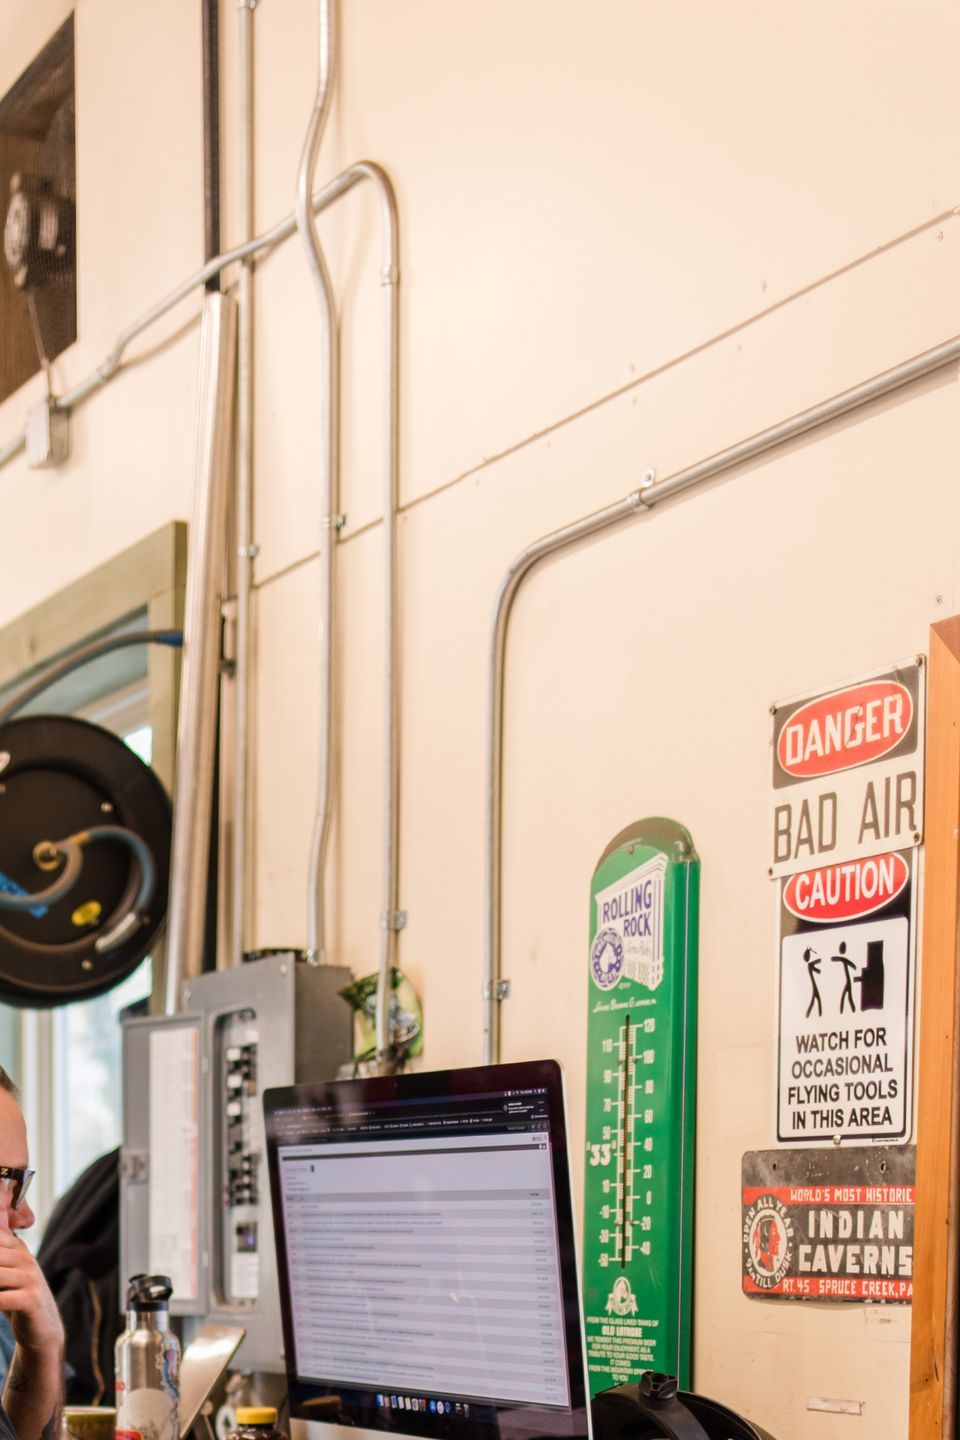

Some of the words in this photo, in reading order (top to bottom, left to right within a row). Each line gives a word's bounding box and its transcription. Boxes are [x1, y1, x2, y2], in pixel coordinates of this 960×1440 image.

[785, 693, 904, 766] DANGER
[773, 791, 837, 864] BAD
[858, 770, 917, 844] AIR
[795, 857, 895, 911] CAUTION
[602, 880, 652, 923] ROLLING
[623, 912, 652, 937] ROCK
[796, 1031, 848, 1054] WATCH
[854, 1027, 887, 1048] FOR
[792, 1053, 893, 1079] OCCASIONAL
[788, 1083, 840, 1105] FLYING
[845, 1079, 898, 1101] TOOLS
[792, 1111, 806, 1130] IN
[811, 1109, 844, 1128] THIS
[848, 1106, 893, 1127] AREA
[790, 1188, 830, 1202] WORLD'S
[834, 1188, 861, 1202] MOST
[866, 1188, 912, 1202] HISTORIC
[743, 1207, 755, 1243] OPEN
[757, 1196, 774, 1210] ALL
[775, 1200, 794, 1237] YEAR
[808, 1210, 904, 1239] INDIAN
[775, 1252, 792, 1282] DUSK
[798, 1244, 913, 1276] CAVERNS
[819, 1280, 856, 1295] SPRUCE
